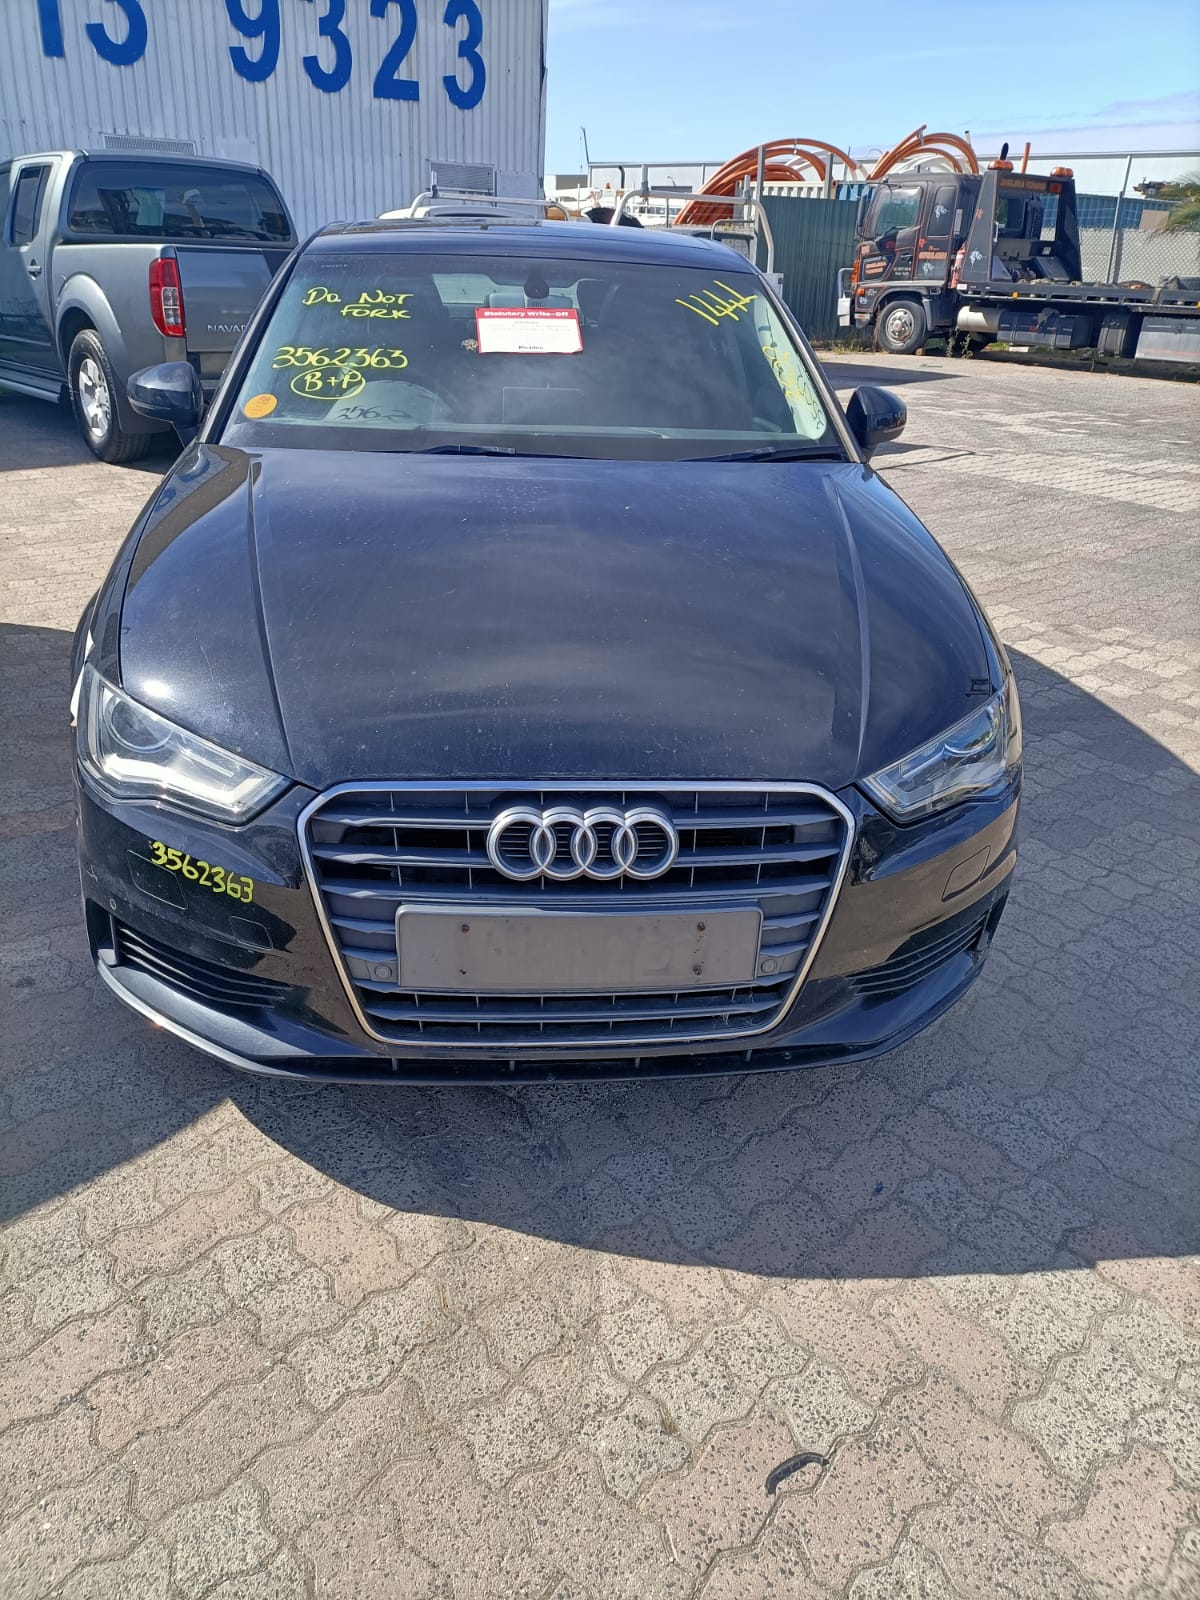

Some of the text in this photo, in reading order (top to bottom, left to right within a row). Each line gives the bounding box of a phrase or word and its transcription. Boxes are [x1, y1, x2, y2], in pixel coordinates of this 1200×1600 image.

[225, 0, 486, 110] 9323
[484, 310, 569, 318] Statutory Write-Off
[272, 345, 409, 369] 3562363
[150, 841, 254, 903] 3562363
